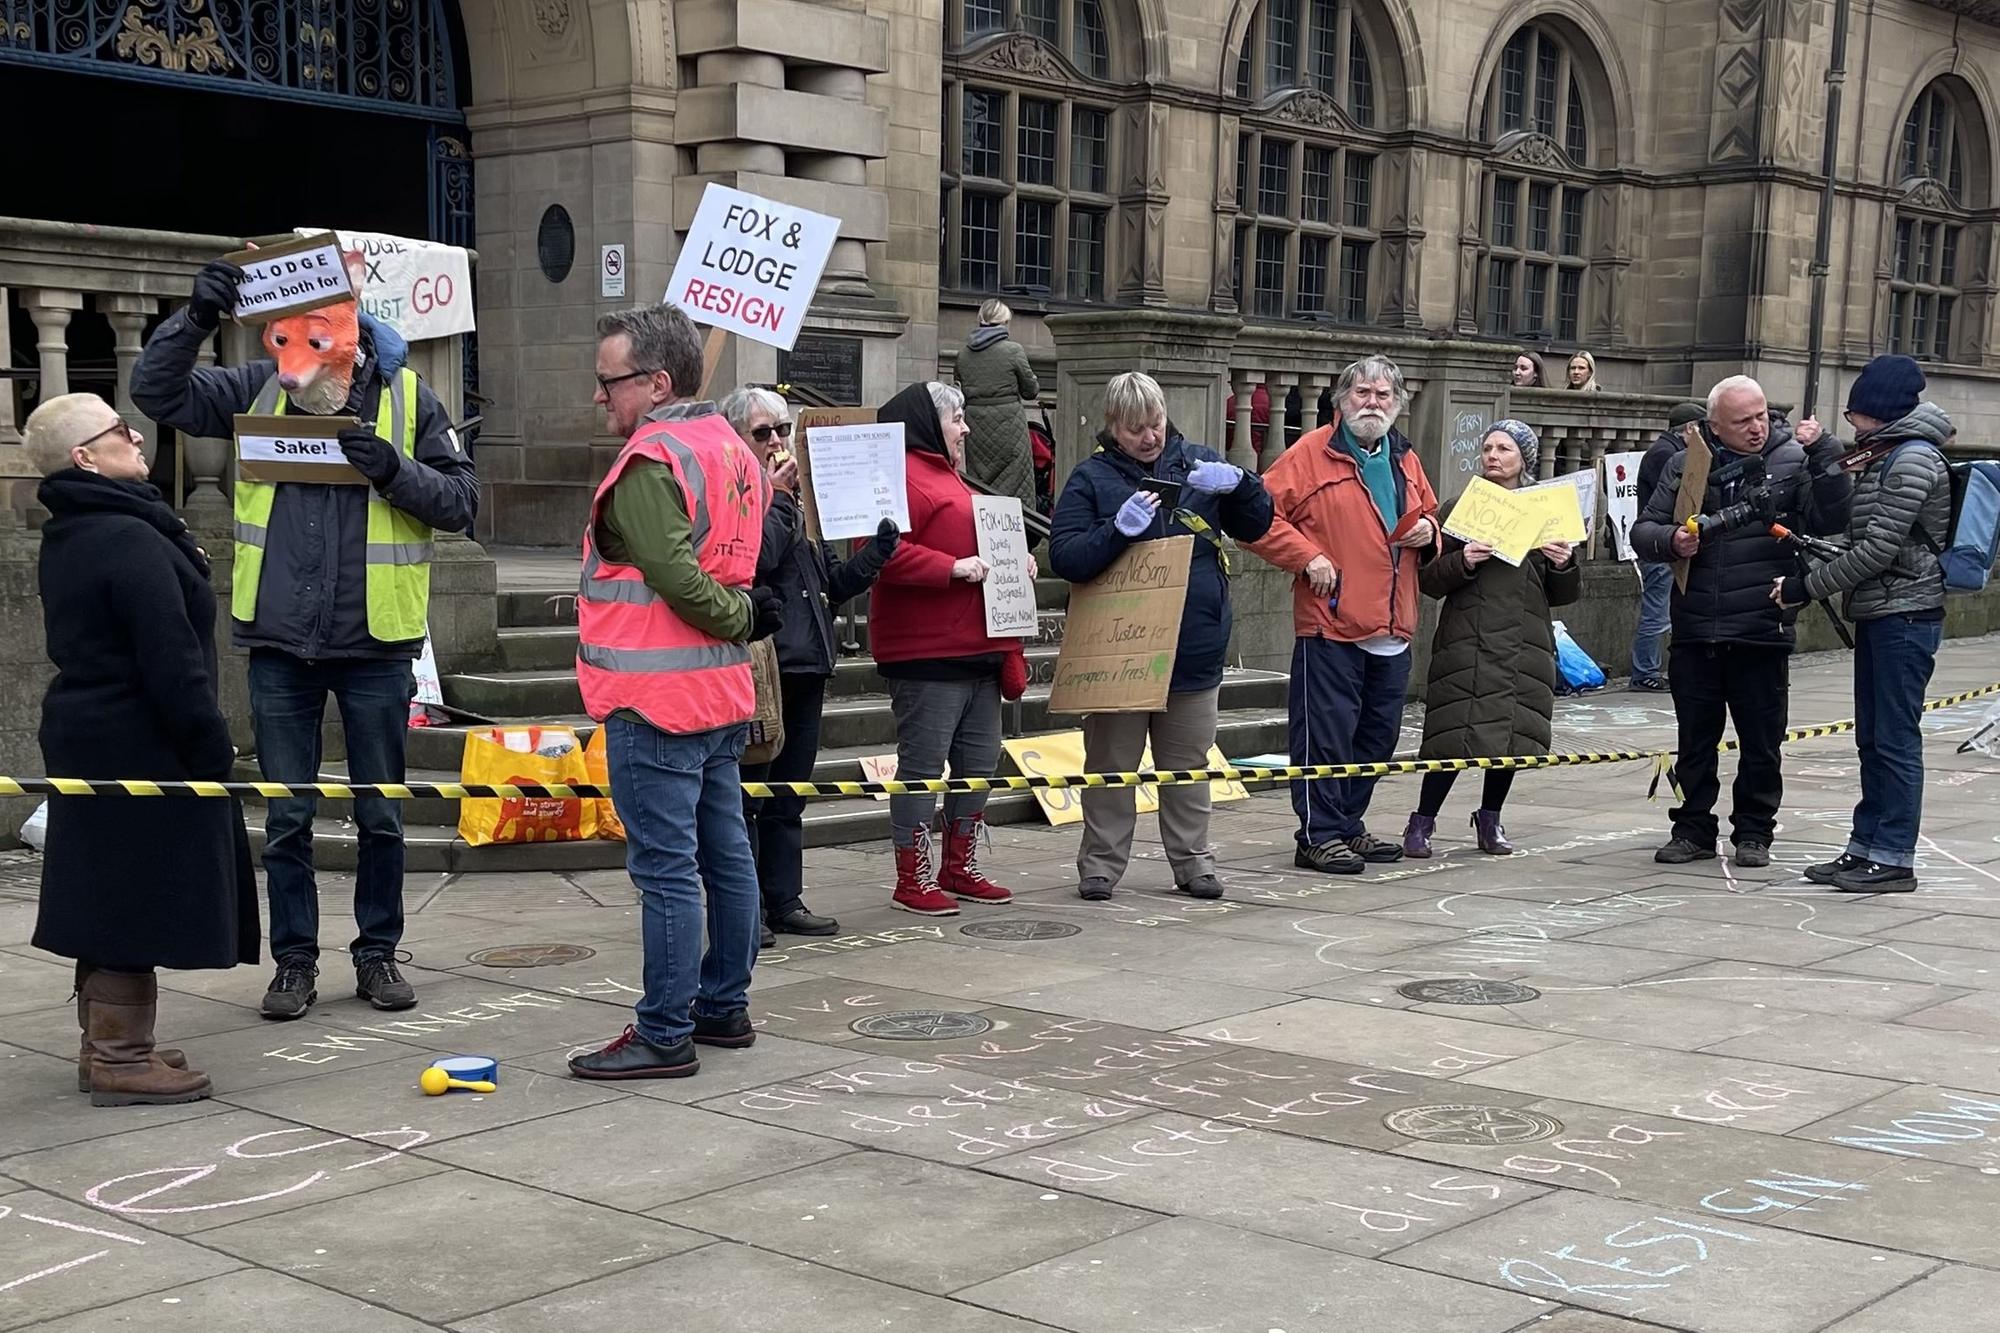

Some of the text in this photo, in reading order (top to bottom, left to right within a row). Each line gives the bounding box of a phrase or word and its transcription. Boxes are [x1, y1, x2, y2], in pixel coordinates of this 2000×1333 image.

[723, 204, 802, 250] FOX &
[352, 238, 407, 256] ODGE
[701, 241, 798, 292] LODGE
[239, 275, 340, 308] them both for
[412, 274, 453, 314] GO
[683, 278, 785, 332] RESIGN
[1453, 411, 1483, 436] TERRY
[274, 440, 328, 456] Sake!
[1459, 454, 1481, 471] OUT
[991, 606, 1017, 628] RESIGN
[1106, 617, 1147, 643] Justice
[522, 807, 537, 816] and
[1498, 1092, 2000, 1301] RESIGN NOW
